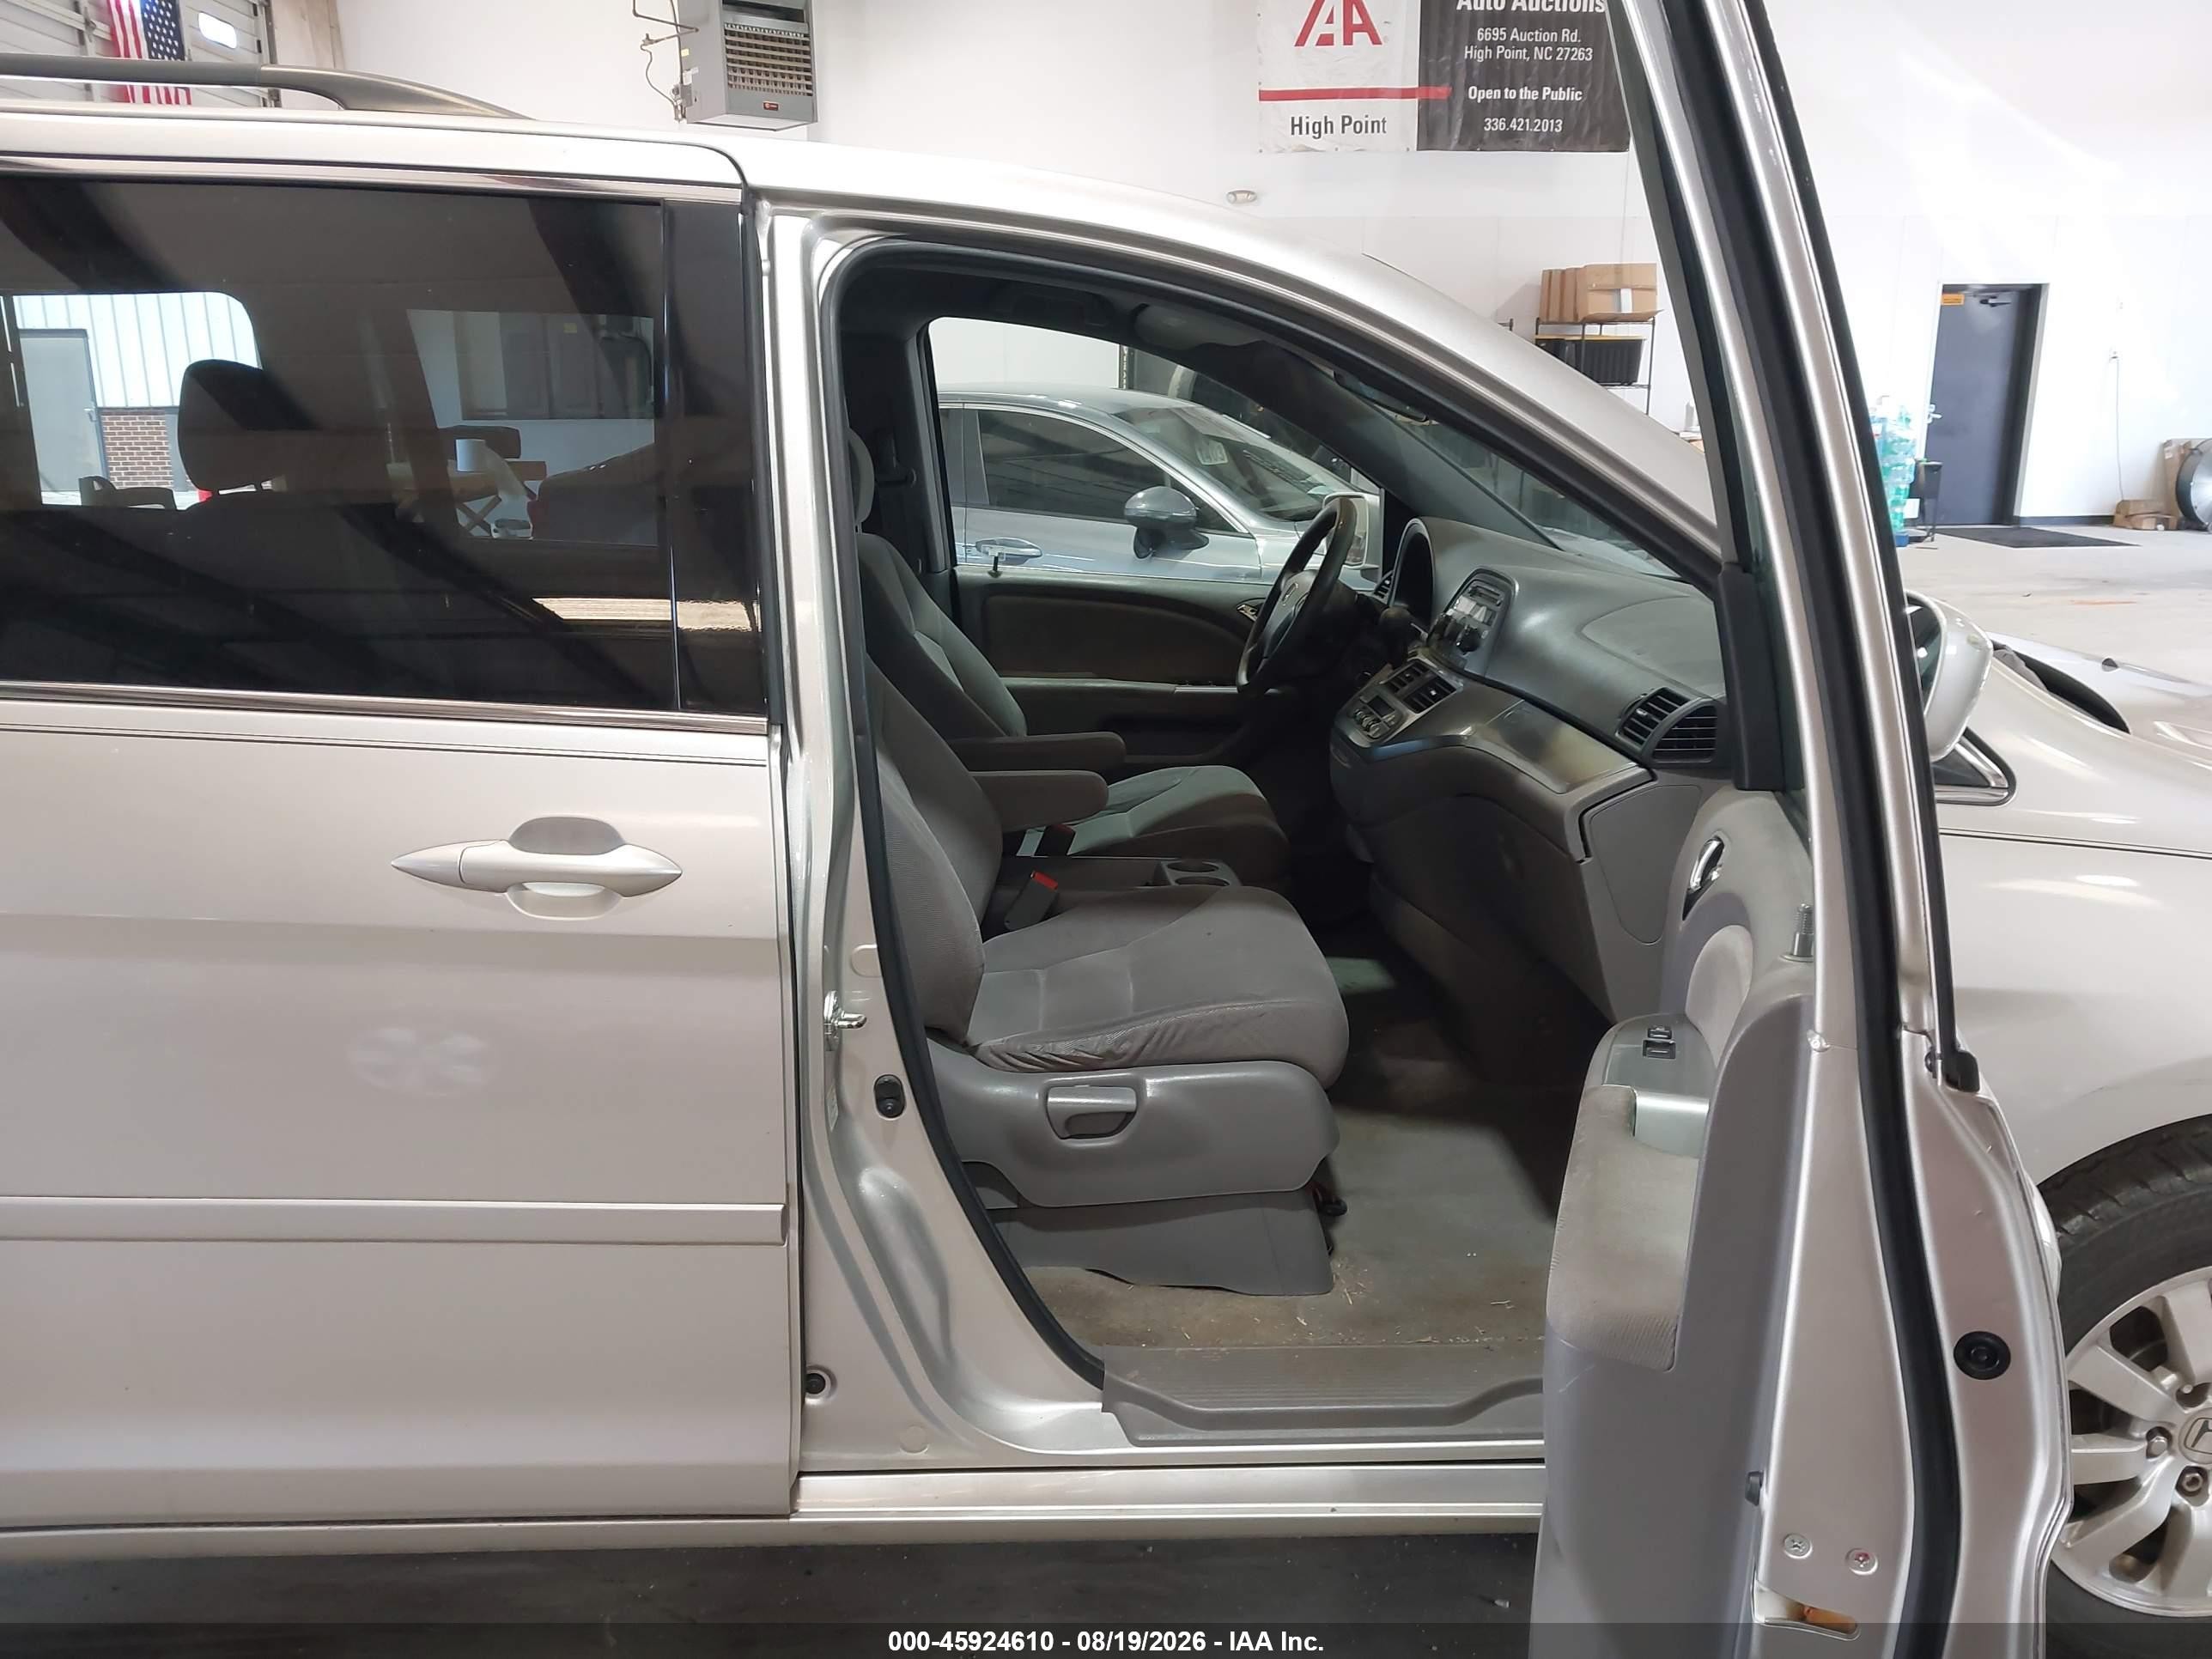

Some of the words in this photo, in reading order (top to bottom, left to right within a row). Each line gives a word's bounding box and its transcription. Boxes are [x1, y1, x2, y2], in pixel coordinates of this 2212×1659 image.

[1477, 27, 1507, 42] 6695
[1510, 27, 1558, 43] Auction
[1561, 28, 1582, 43] Rd.
[1464, 46, 1492, 63] High
[1496, 46, 1531, 62] Point,
[1534, 46, 1553, 61] NC
[1556, 47, 1593, 61] 27263
[1468, 86, 1501, 103] Open
[1504, 87, 1516, 100] to
[1519, 87, 1540, 100] the
[1542, 87, 1583, 101] Public
[1291, 116, 1334, 139] High
[1341, 115, 1387, 134] Point
[1484, 118, 1563, 132] 336.421.2013
